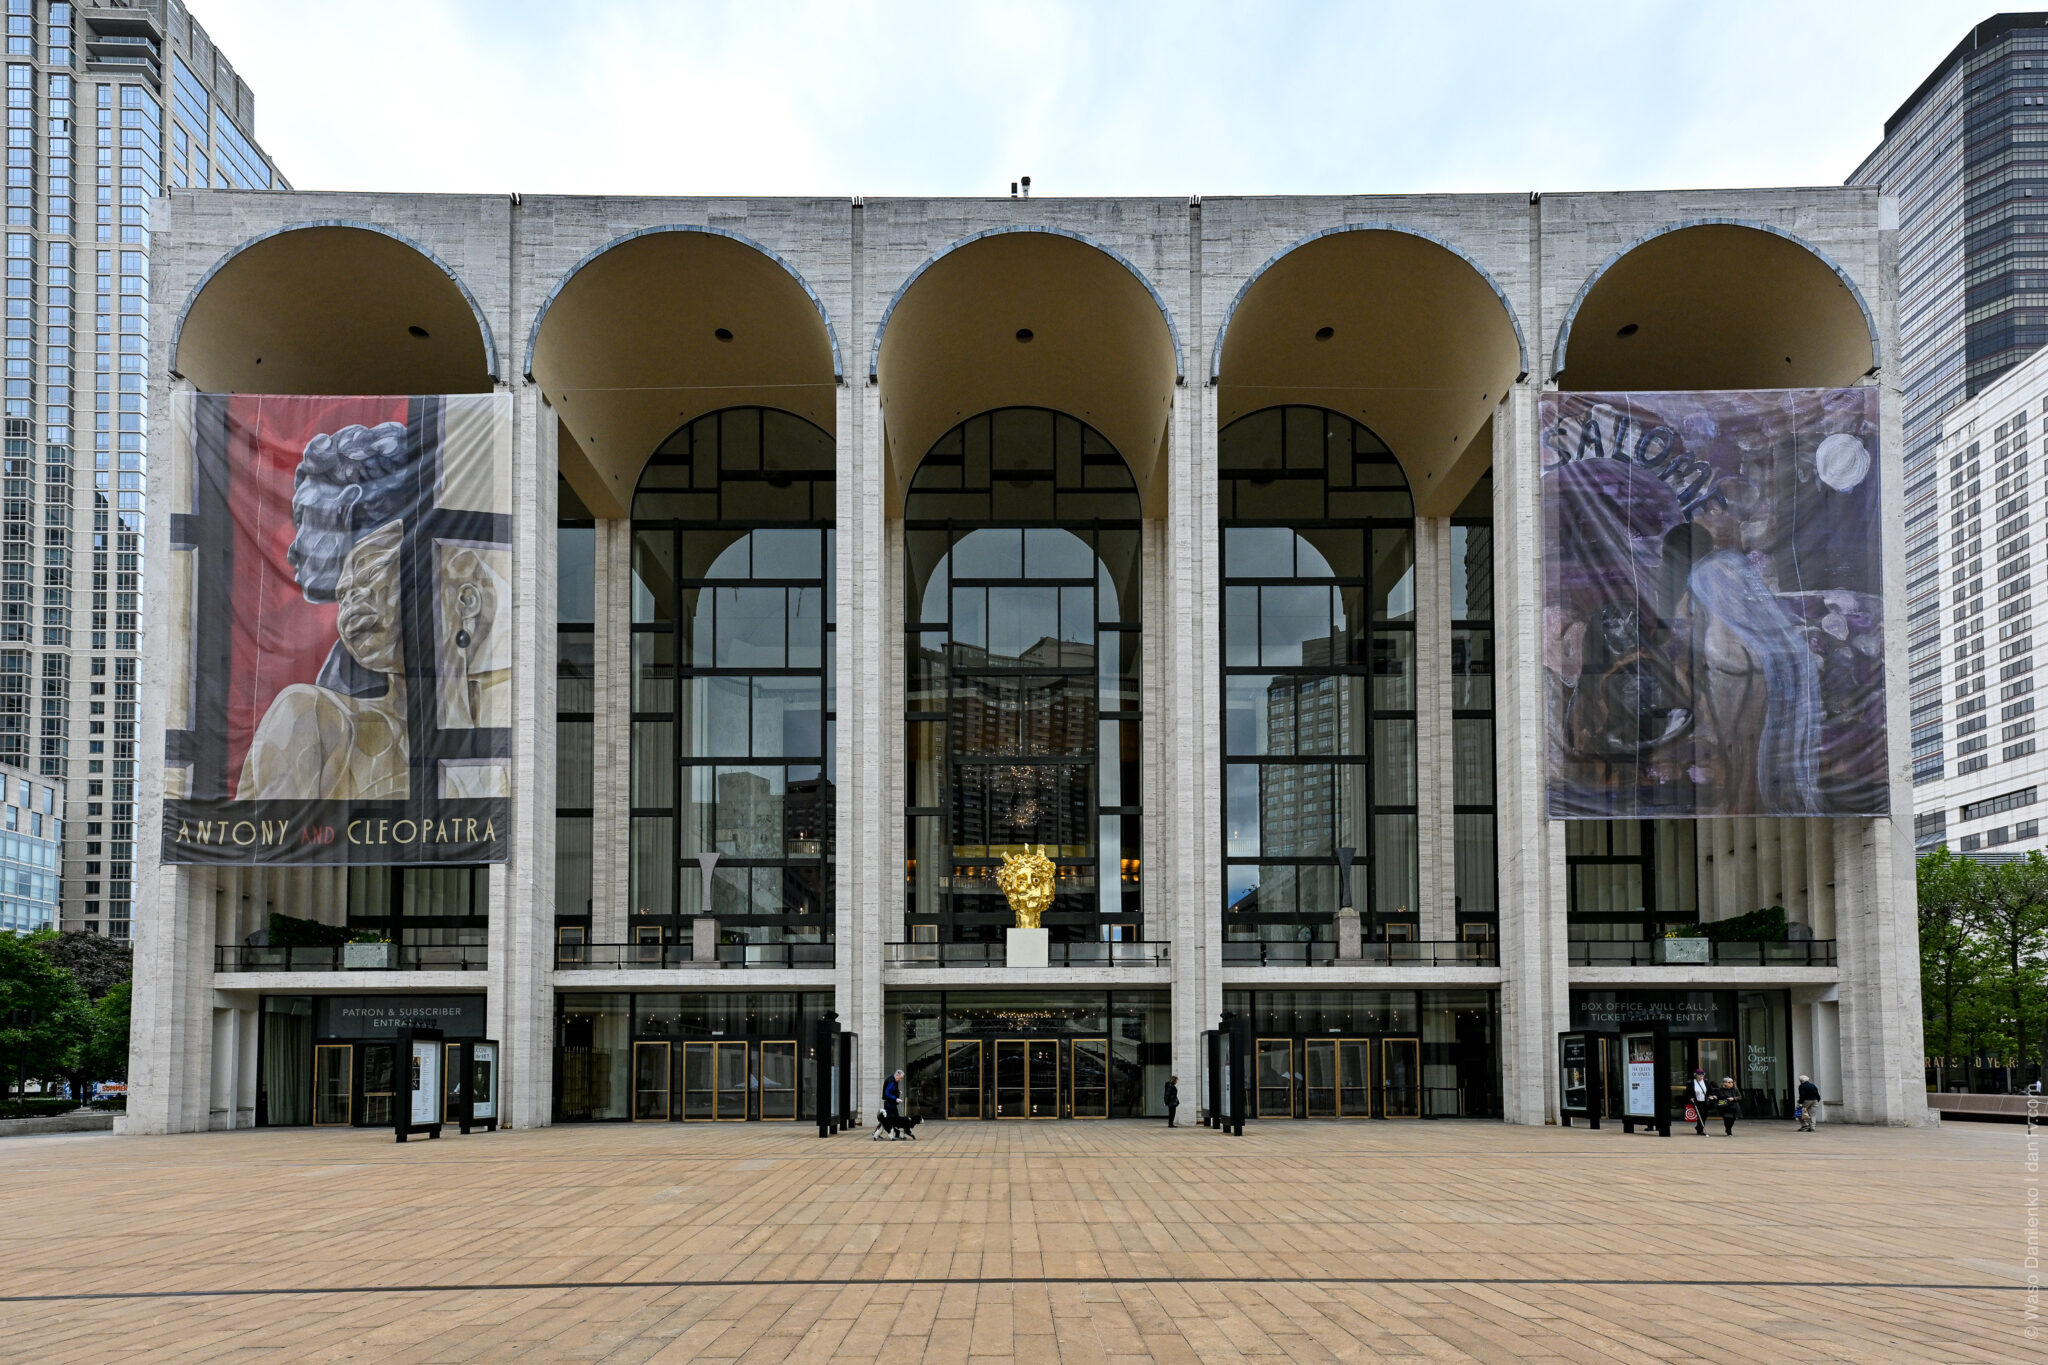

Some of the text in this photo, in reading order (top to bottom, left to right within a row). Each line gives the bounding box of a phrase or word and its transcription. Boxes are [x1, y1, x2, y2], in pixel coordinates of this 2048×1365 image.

[176, 817, 497, 845] ANTONY AND CLEOPATRA
[342, 1007, 461, 1017] PATRON & SUBSCRIBER
[1581, 1002, 1602, 1011] BOX
[1649, 1002, 1675, 1011] WILL
[1678, 1002, 1707, 1012] CALL,
[1711, 1002, 1719, 1011] &
[1590, 1013, 1627, 1022] TICKET
[1676, 1013, 1709, 1022] ENTRY
[1748, 1045, 1766, 1054] Met
[1748, 1054, 1777, 1064] Opera
[1748, 1063, 1769, 1075] Shop
